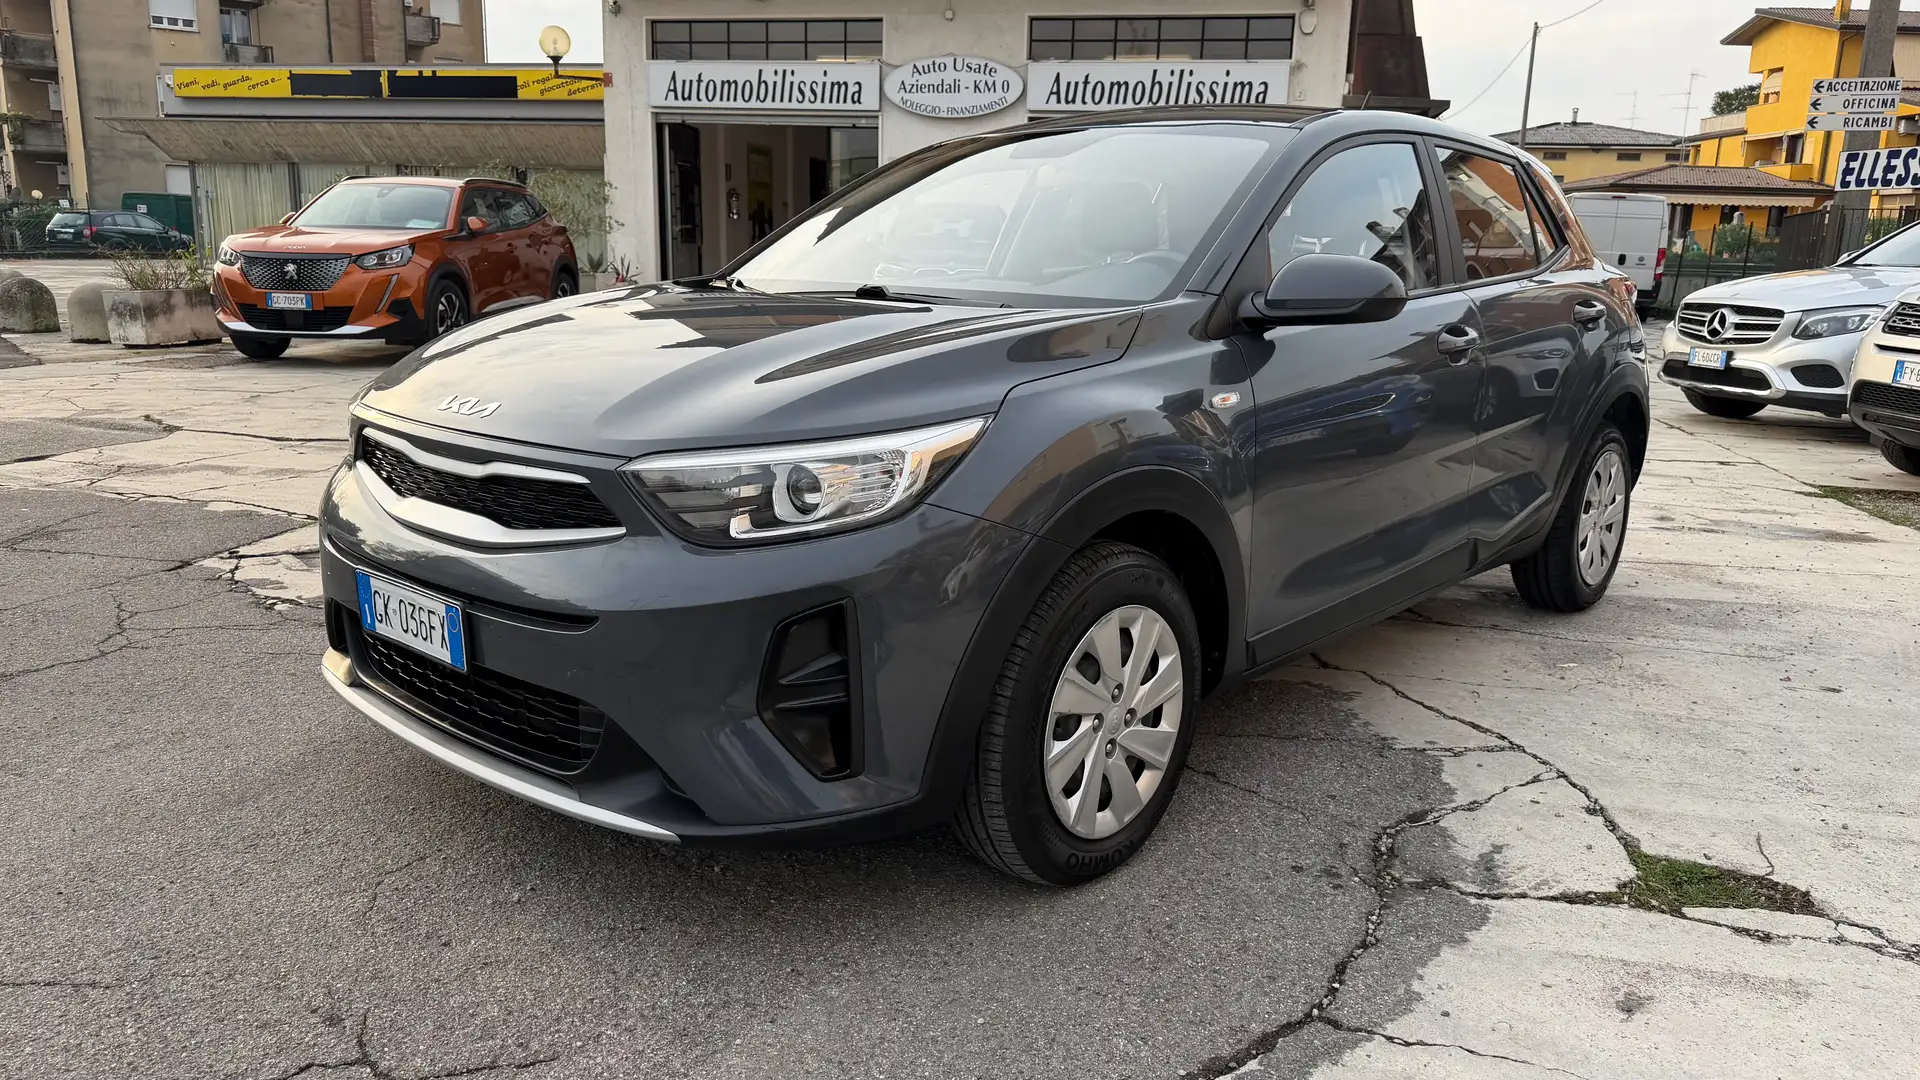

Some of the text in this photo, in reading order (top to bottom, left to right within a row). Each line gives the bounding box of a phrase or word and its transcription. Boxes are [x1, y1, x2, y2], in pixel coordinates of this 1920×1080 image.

[911, 57, 998, 78] Auto Usate
[176, 78, 200, 90] Vieni,
[201, 79, 220, 90] vedi,
[222, 74, 252, 91] guarda,
[247, 79, 269, 91] cerca
[664, 68, 863, 105] Automobilissima
[897, 79, 961, 94] Aziendali
[973, 79, 997, 94] KM
[1001, 79, 1010, 94] 0
[1045, 68, 1269, 105] Automobilissima
[1826, 80, 1901, 93] ACCETTAZIONE
[899, 96, 941, 115] NOLEGGIO
[946, 96, 1008, 116] FINANZIAMENTI
[1843, 98, 1896, 109] OFFICINA
[1843, 117, 1893, 128] RICAMBI
[373, 589, 394, 629] GK
[398, 598, 449, 652] 036FX
